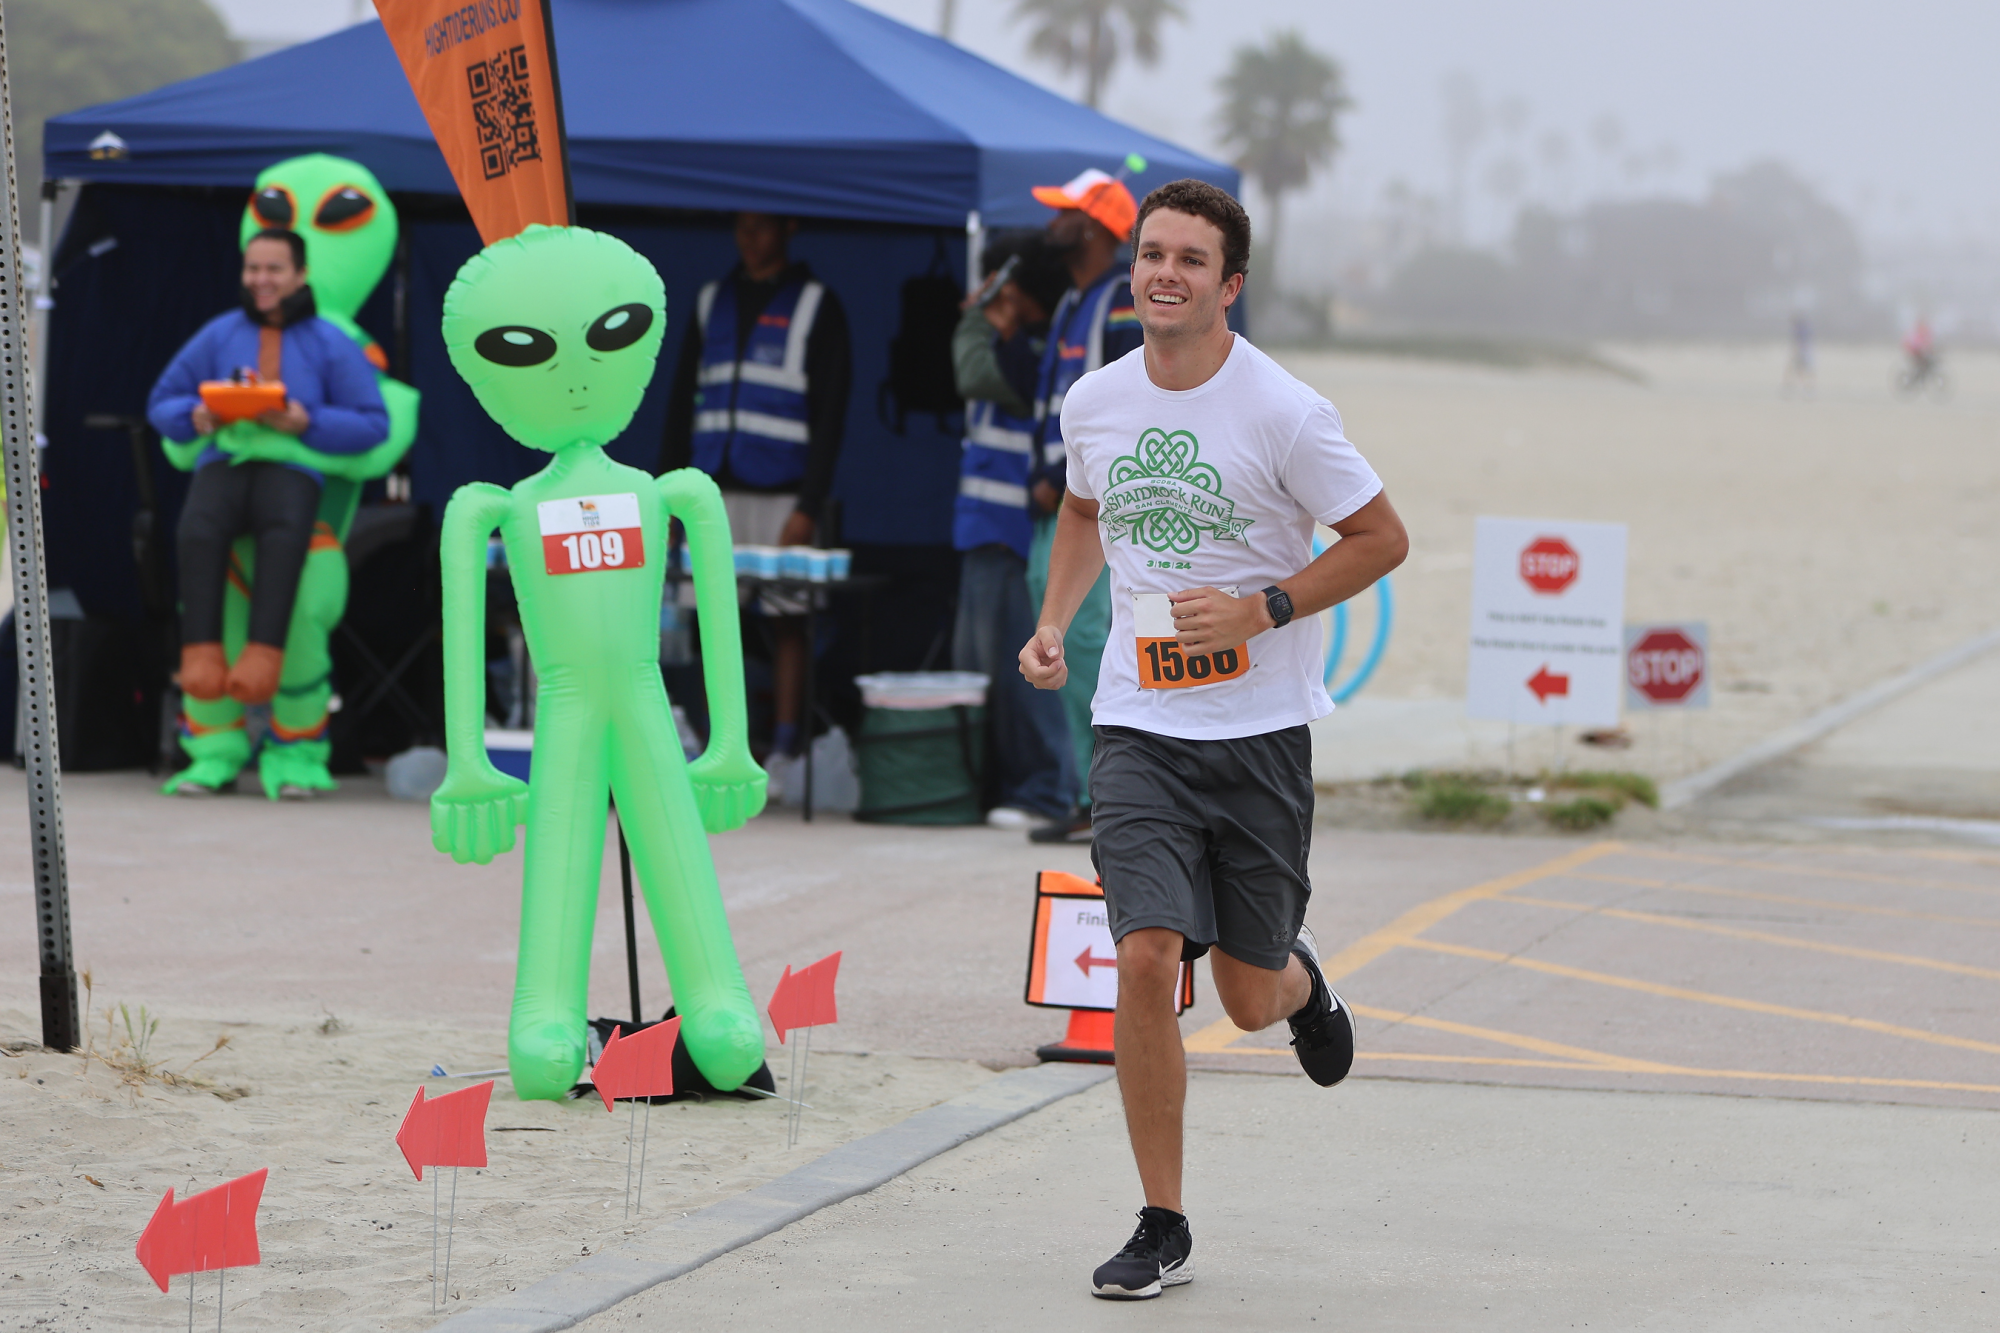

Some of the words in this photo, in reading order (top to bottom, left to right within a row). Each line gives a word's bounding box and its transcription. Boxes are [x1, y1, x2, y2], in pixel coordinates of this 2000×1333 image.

[1135, 501, 1153, 510] SAN
[1190, 492, 1226, 519] RUN
[562, 530, 625, 570] 109
[1524, 552, 1573, 579] STOP
[1630, 649, 1698, 686] STOP
